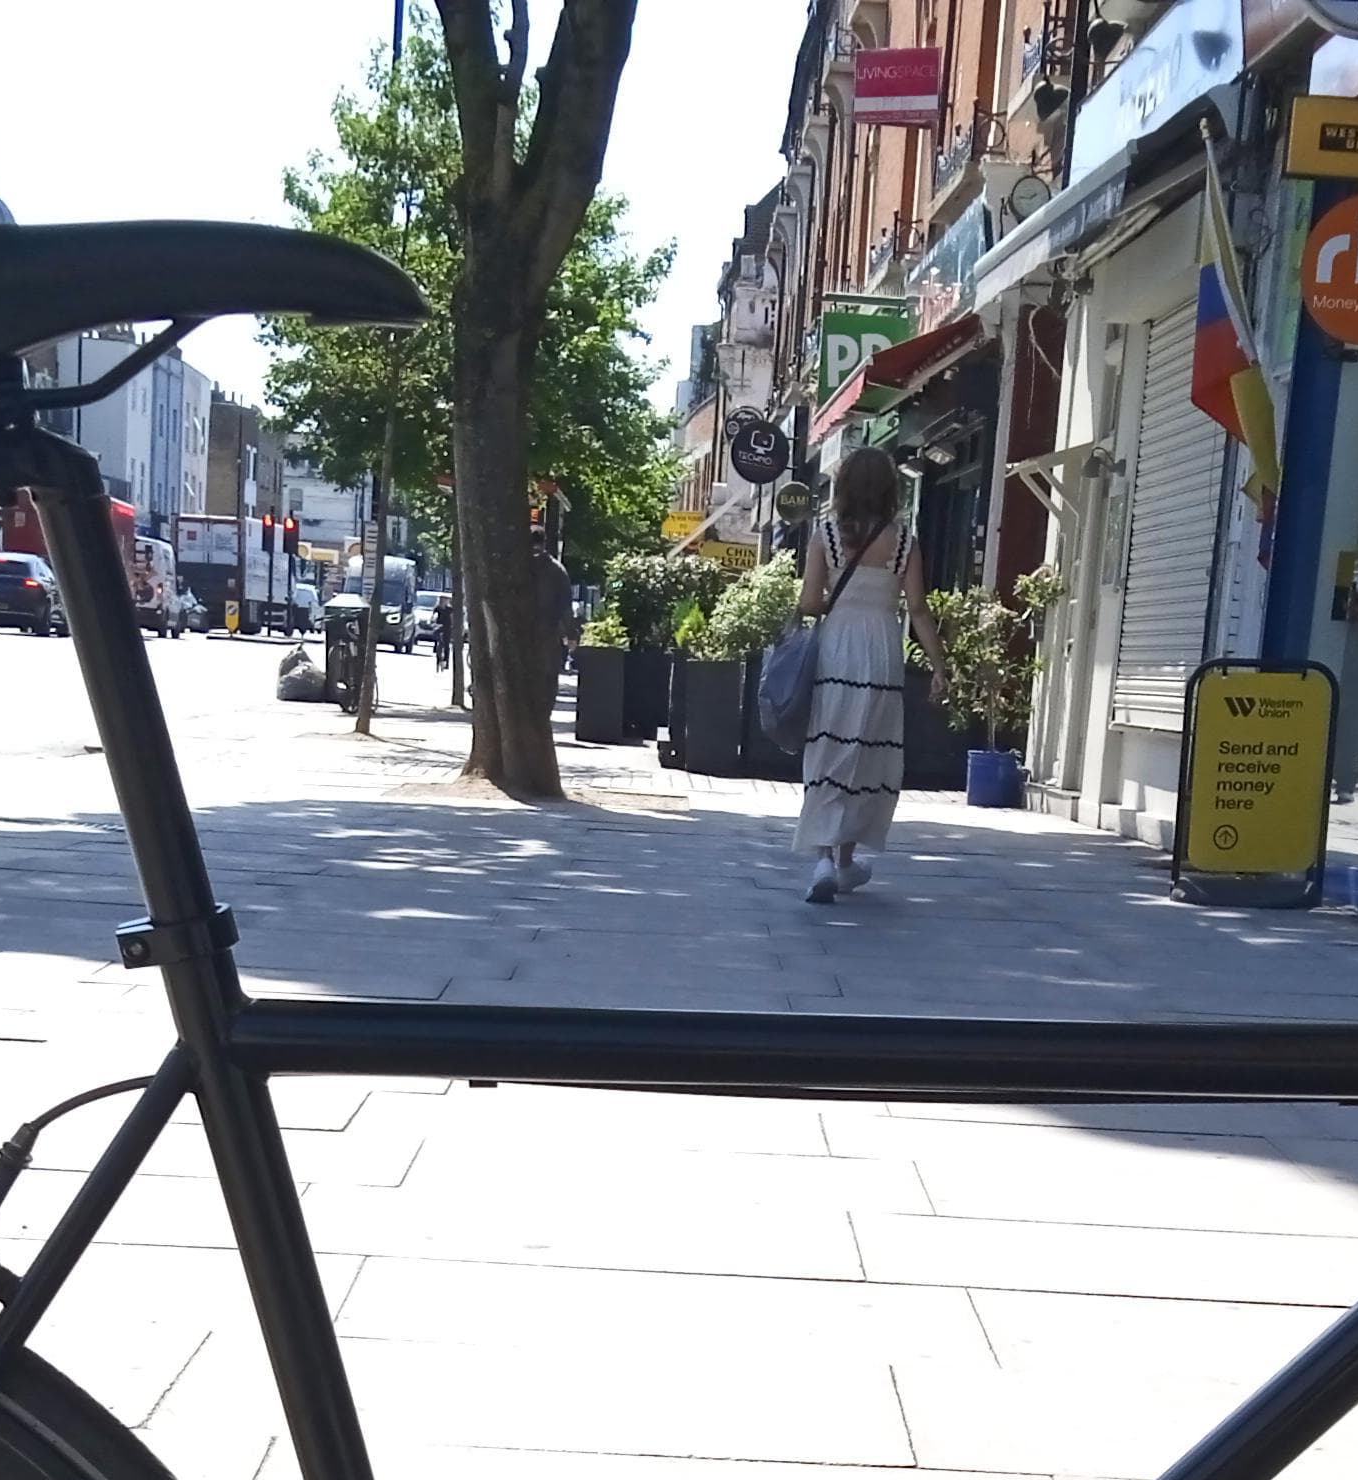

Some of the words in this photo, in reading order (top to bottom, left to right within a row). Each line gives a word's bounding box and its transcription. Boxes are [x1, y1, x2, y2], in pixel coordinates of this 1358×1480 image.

[1259, 697, 1304, 709] Western
[1258, 708, 1291, 719] Union
[1218, 740, 1264, 756] Send
[1267, 742, 1299, 756] and
[1217, 760, 1281, 774] receive
[1216, 780, 1275, 795] money
[1215, 796, 1255, 810] here
